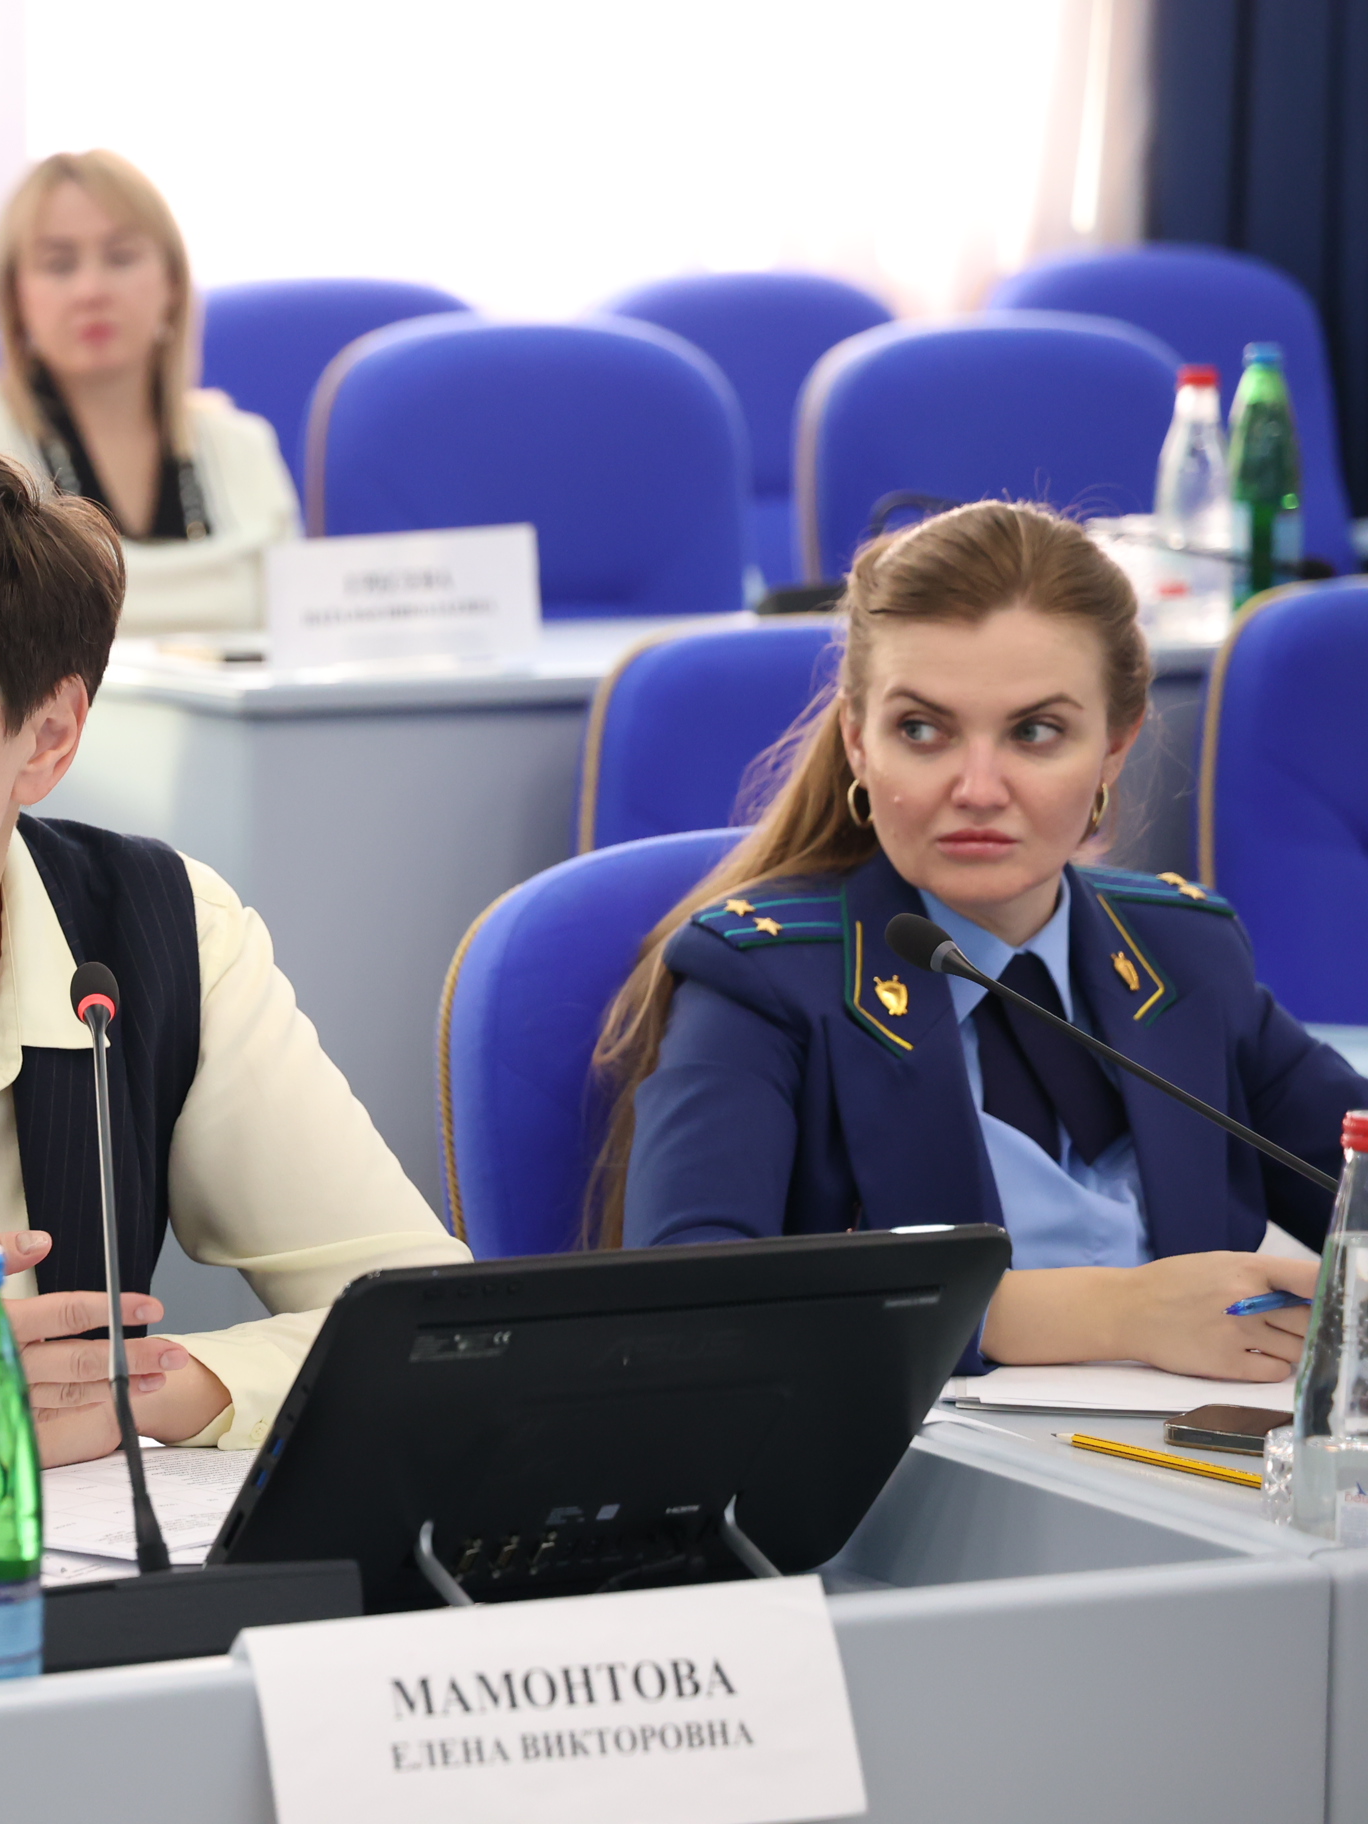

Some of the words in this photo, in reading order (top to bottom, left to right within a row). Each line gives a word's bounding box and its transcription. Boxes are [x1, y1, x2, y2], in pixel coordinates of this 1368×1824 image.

[390, 1657, 737, 1719] МАМОНТОВА
[391, 1734, 510, 1773] ЕЛЕНА
[521, 1718, 755, 1763] ВИКТОРОВНА
